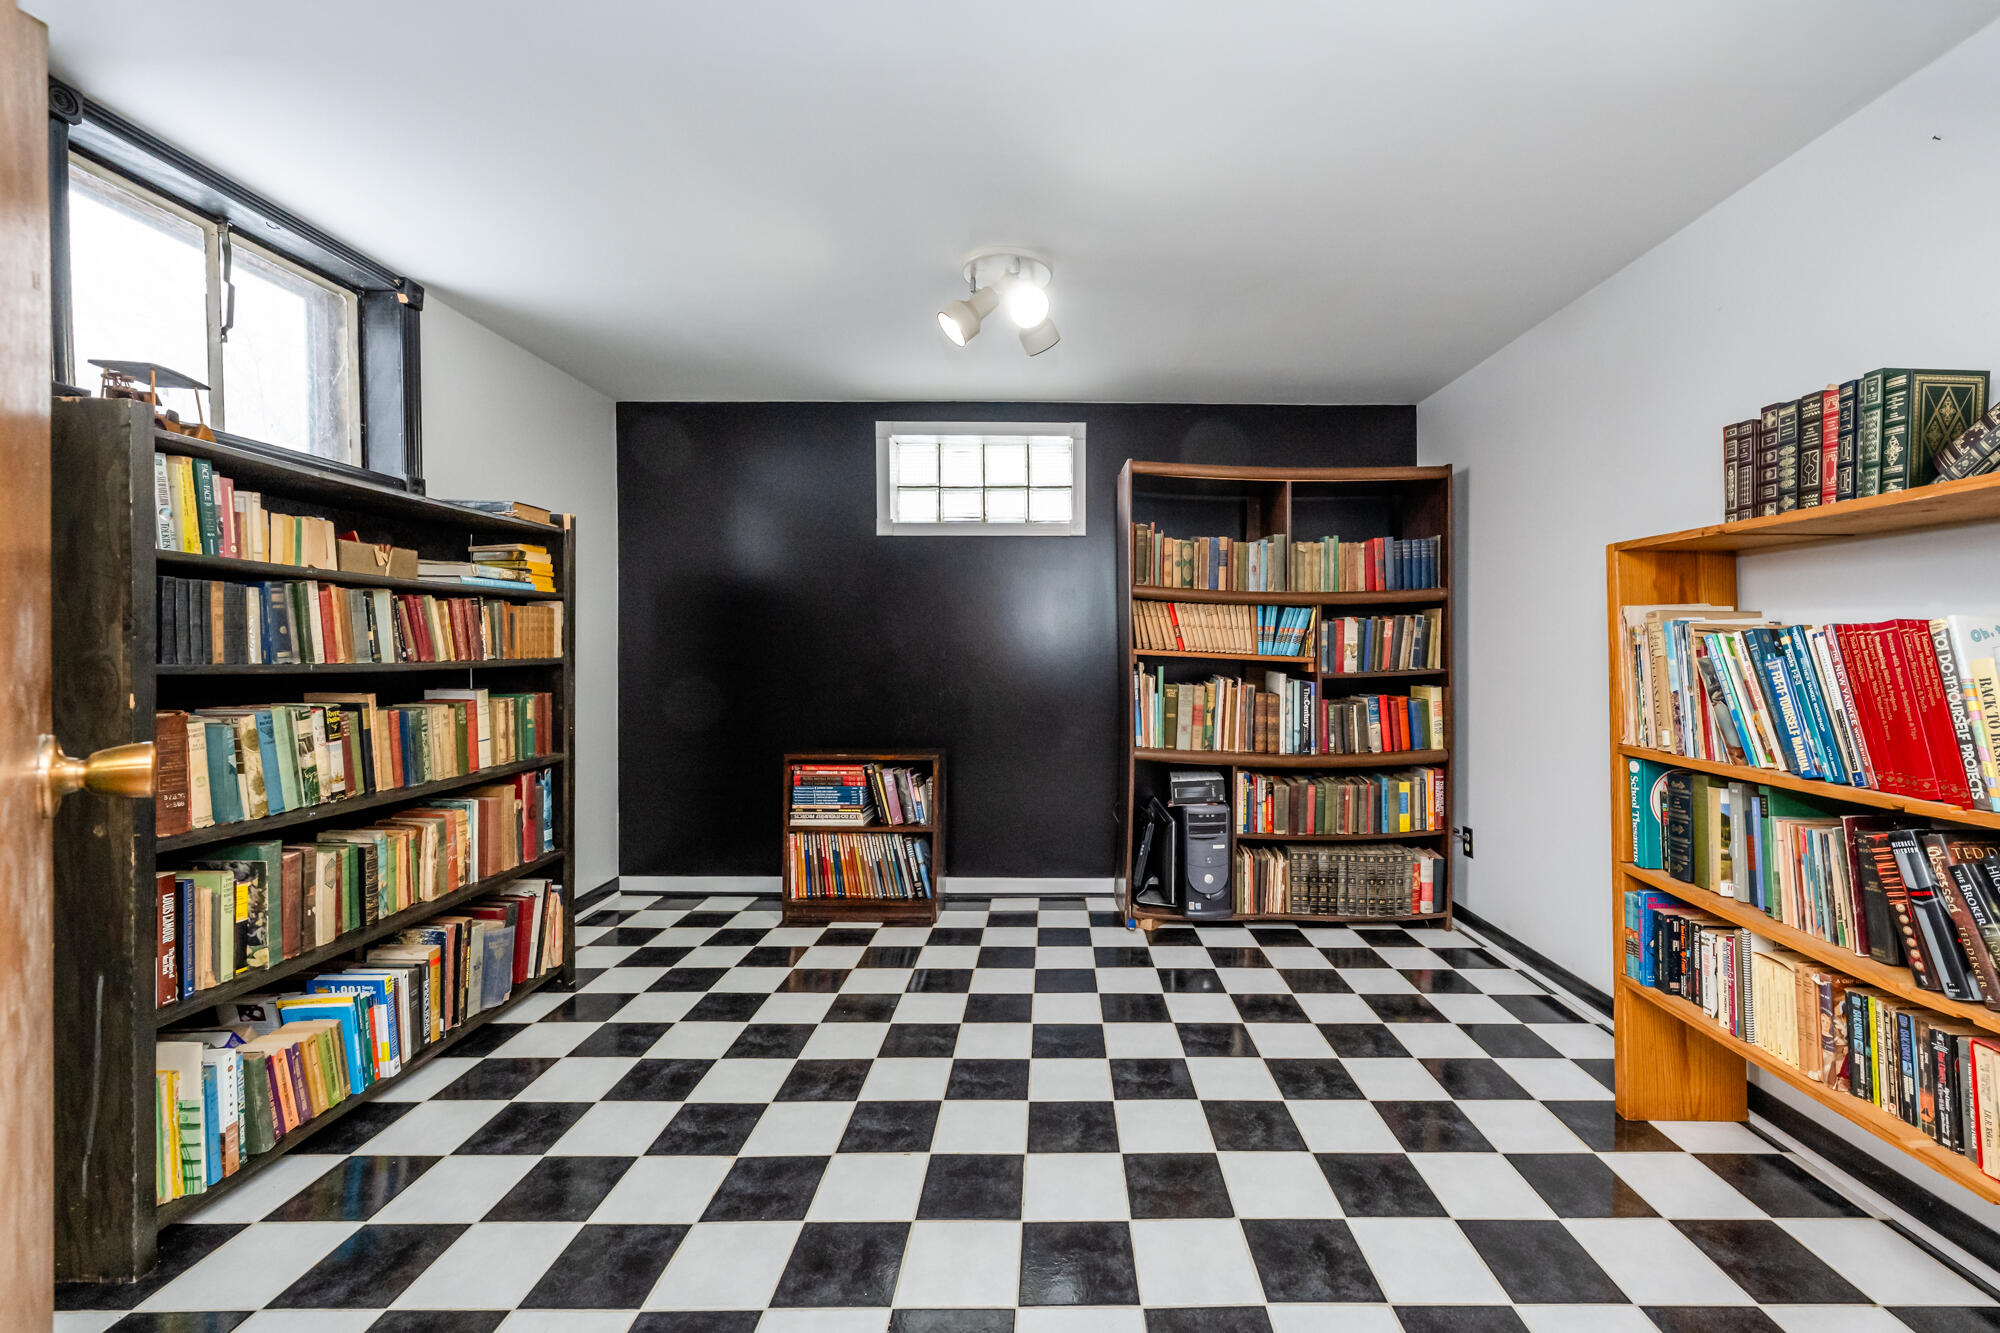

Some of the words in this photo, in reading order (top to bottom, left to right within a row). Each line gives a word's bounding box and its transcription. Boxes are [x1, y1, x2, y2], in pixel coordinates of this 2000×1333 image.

[201, 463, 210, 479] FACE
[203, 485, 211, 501] FACE
[160, 522, 171, 549] TOLKIEN
[1934, 634, 1950, 652] 101
[1970, 627, 1995, 644] Oh,
[1785, 648, 1796, 668] Decks
[1933, 678, 1941, 699] Projects
[1938, 654, 1971, 741] DO-IT-YOURSELF
[1979, 677, 1997, 710] BACK
[1303, 700, 1311, 728] Century
[1771, 671, 1800, 736] FIX-IT-YOURSELF
[1791, 736, 1810, 775] MANUAL
[1834, 664, 1846, 686] NEW
[1841, 687, 1858, 725] YANKEE
[1853, 727, 1868, 767] WORKSHOP
[1986, 712, 2000, 730] TO
[1962, 743, 1985, 801] PROJECTS
[1630, 775, 1641, 808] School
[1631, 811, 1642, 863] Thesaurus
[1891, 840, 1915, 848] MICHAEL
[1951, 847, 1985, 860] TED
[1870, 846, 1908, 905] DOMINION
[1926, 846, 1962, 914] Obsessed
[162, 892, 175, 914] LOUIS
[1954, 869, 1966, 884] THE
[1960, 883, 1987, 926] BROKER
[162, 913, 175, 944] L'AMOUR
[1726, 940, 1734, 986] Executricks
[1958, 927, 1971, 946] TED
[1967, 948, 1988, 988] DEKKER
[1984, 1127, 1993, 1148] Tolkien
